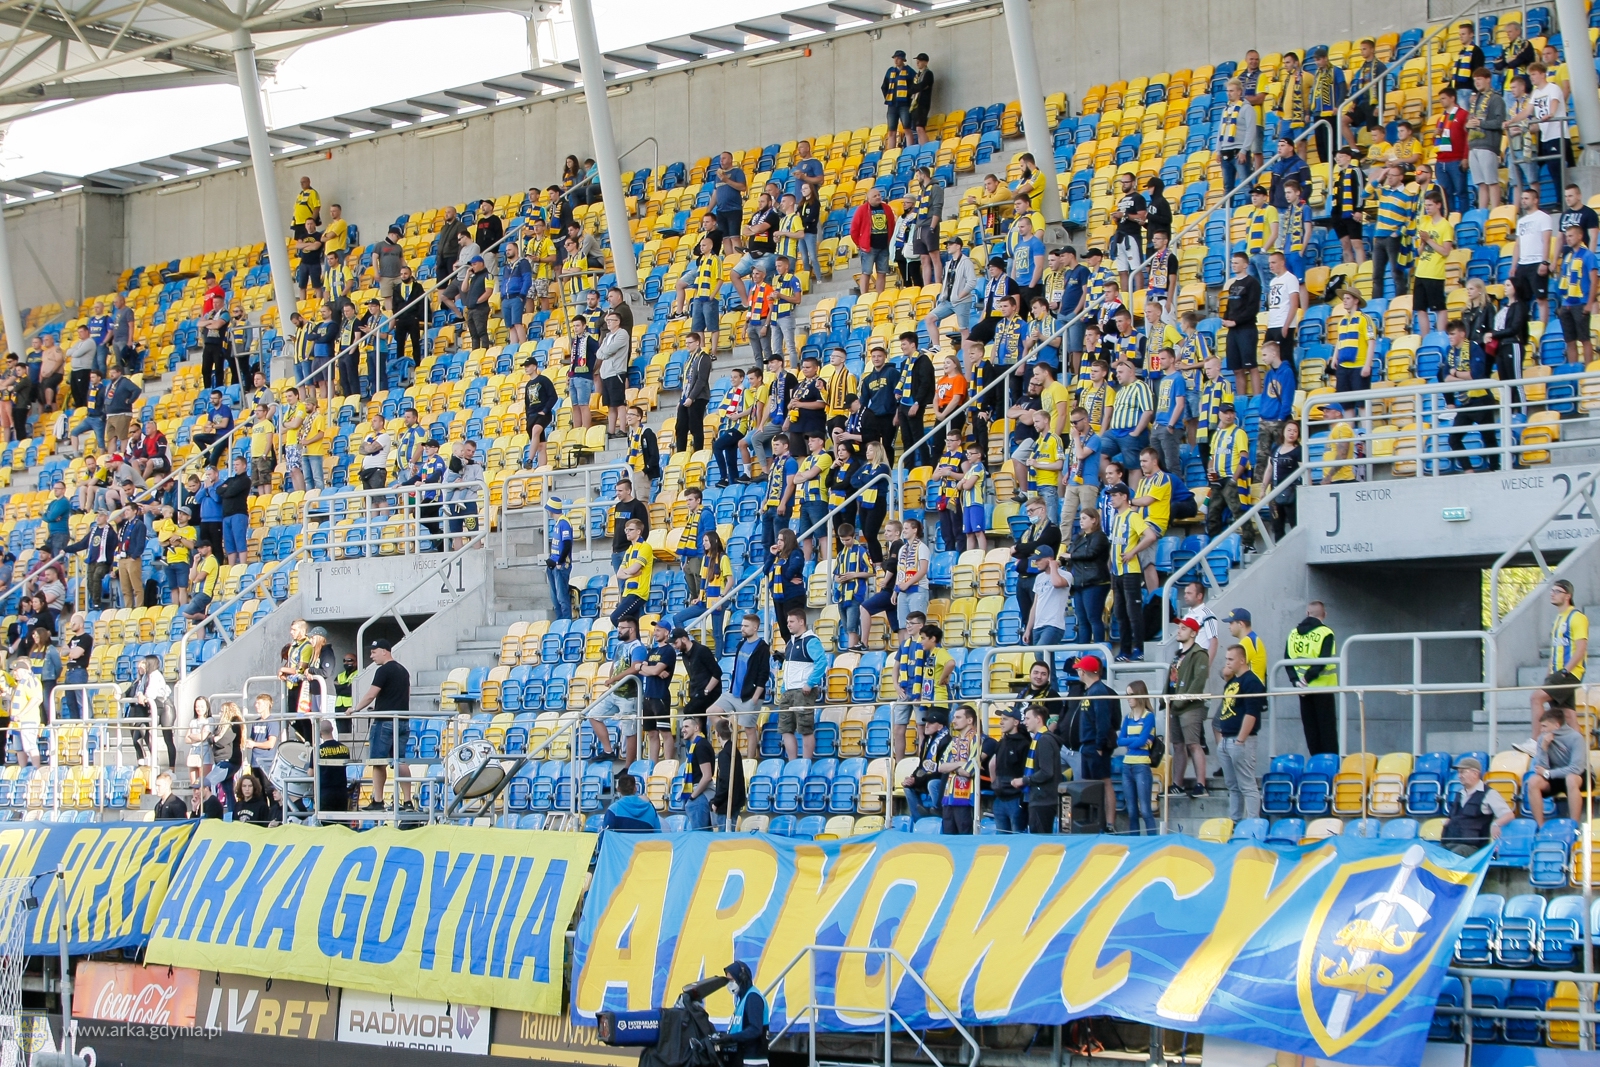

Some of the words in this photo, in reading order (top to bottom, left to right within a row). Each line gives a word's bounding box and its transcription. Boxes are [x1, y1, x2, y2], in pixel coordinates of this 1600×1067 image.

[1326, 492, 1341, 537] J
[1355, 488, 1392, 502] SEKTOR
[1552, 472, 1597, 520] 22
[1320, 544, 1351, 555] MIEJSCA
[1353, 542, 1374, 554] 40-21
[1547, 528, 1582, 540] MIEJSCA
[330, 567, 352, 577] SEKTOR
[440, 557, 465, 593] 21
[32, 823, 195, 944] ARKA
[151, 837, 324, 951] ARKA
[318, 845, 567, 984] GDYNIA
[576, 838, 1338, 1023] ARKOWCY
[93, 980, 178, 1025] Coca-Cola
[350, 1009, 454, 1039] RADMOR
